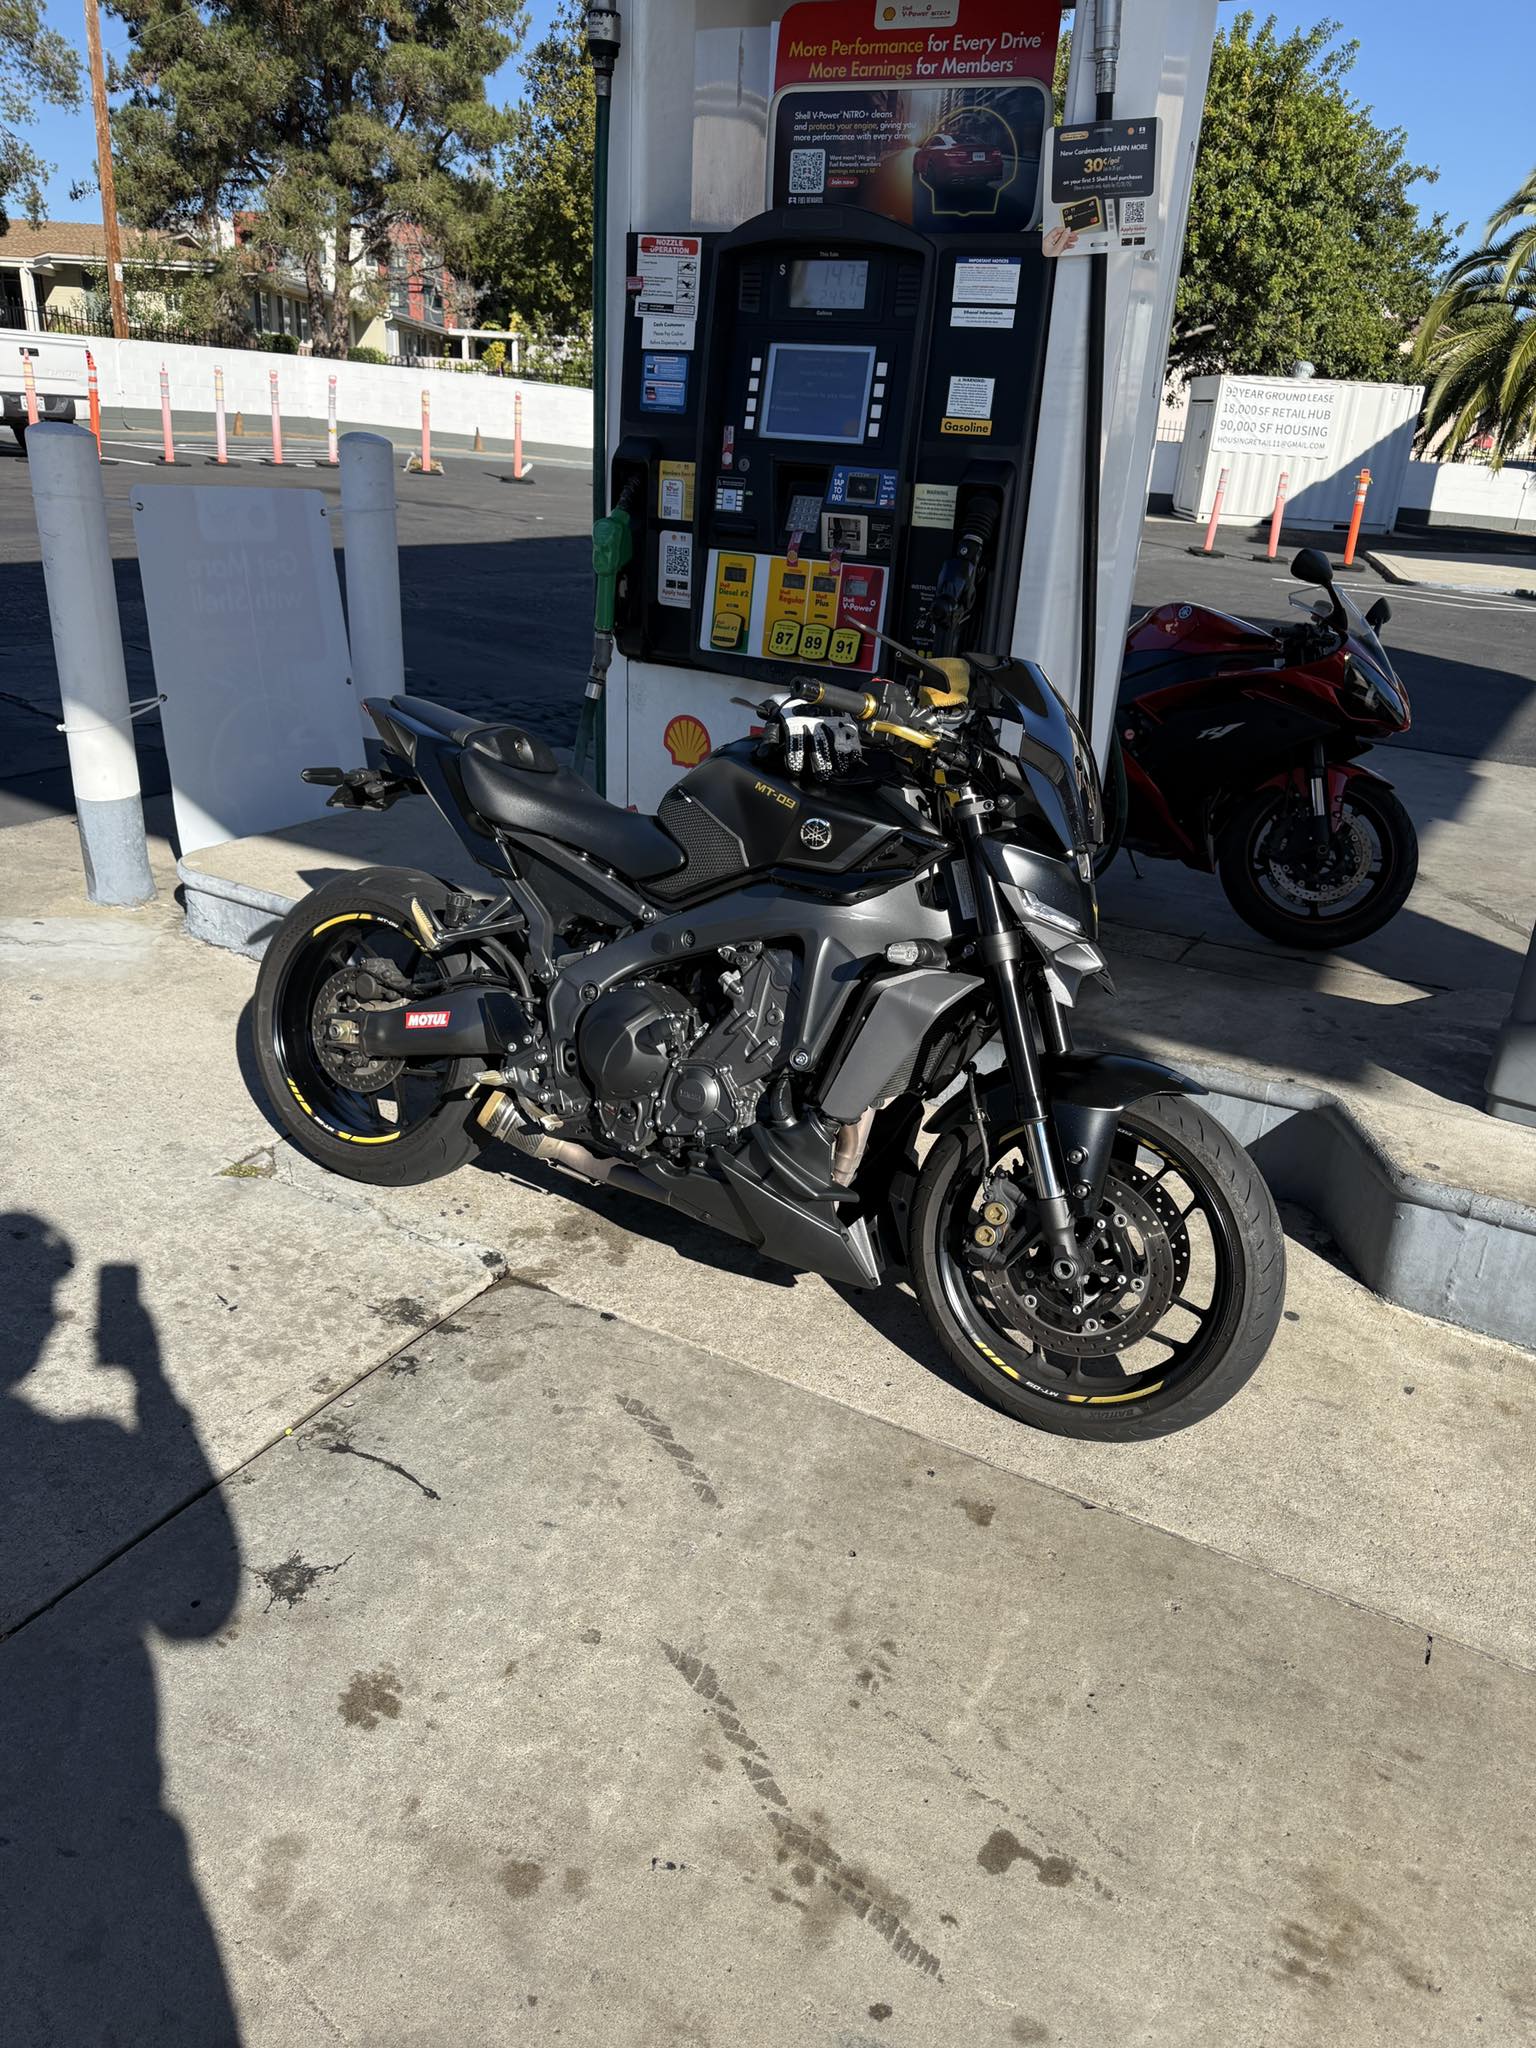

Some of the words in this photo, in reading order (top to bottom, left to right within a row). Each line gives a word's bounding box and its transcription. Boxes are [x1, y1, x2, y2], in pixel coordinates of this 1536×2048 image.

[788, 41, 827, 58] More
[831, 37, 924, 57] Performance
[927, 33, 948, 53] for
[953, 33, 997, 55] Every
[808, 63, 847, 79] More
[851, 60, 912, 80] Earnings
[916, 56, 937, 76] for
[794, 110, 811, 120] Shell
[870, 110, 893, 119] cleans
[794, 123, 808, 131] and
[808, 122, 836, 132] protects
[836, 124, 852, 132] your
[880, 121, 902, 131] giving
[903, 122, 917, 130] you
[793, 134, 811, 142] more
[812, 132, 854, 143] performance
[856, 132, 872, 140] with
[873, 134, 893, 142] every
[1074, 146, 1112, 156] Cardmembers
[649, 246, 690, 254] OPERATION
[779, 264, 786, 276] $
[1239, 388, 1264, 399] YEAR
[1265, 391, 1306, 402] GROUND
[1308, 393, 1335, 403] LEASE
[1223, 402, 1257, 416] 18,000
[1258, 406, 1271, 416] SF
[1272, 408, 1307, 419] RETAIL
[1308, 409, 1332, 420] HUB
[944, 421, 988, 432] Gasoline
[1220, 420, 1257, 433] 90,000
[1259, 422, 1273, 433] SF
[1274, 424, 1328, 437] HOUSING
[719, 588, 738, 596] Diesel
[778, 595, 805, 604] Regular
[815, 598, 829, 607] Plus
[842, 602, 873, 613] V-Power
[775, 632, 794, 646] 87
[804, 636, 822, 650] 89
[836, 640, 854, 654] 91
[754, 781, 797, 809] MT-09
[408, 1014, 447, 1026] MOTUL
